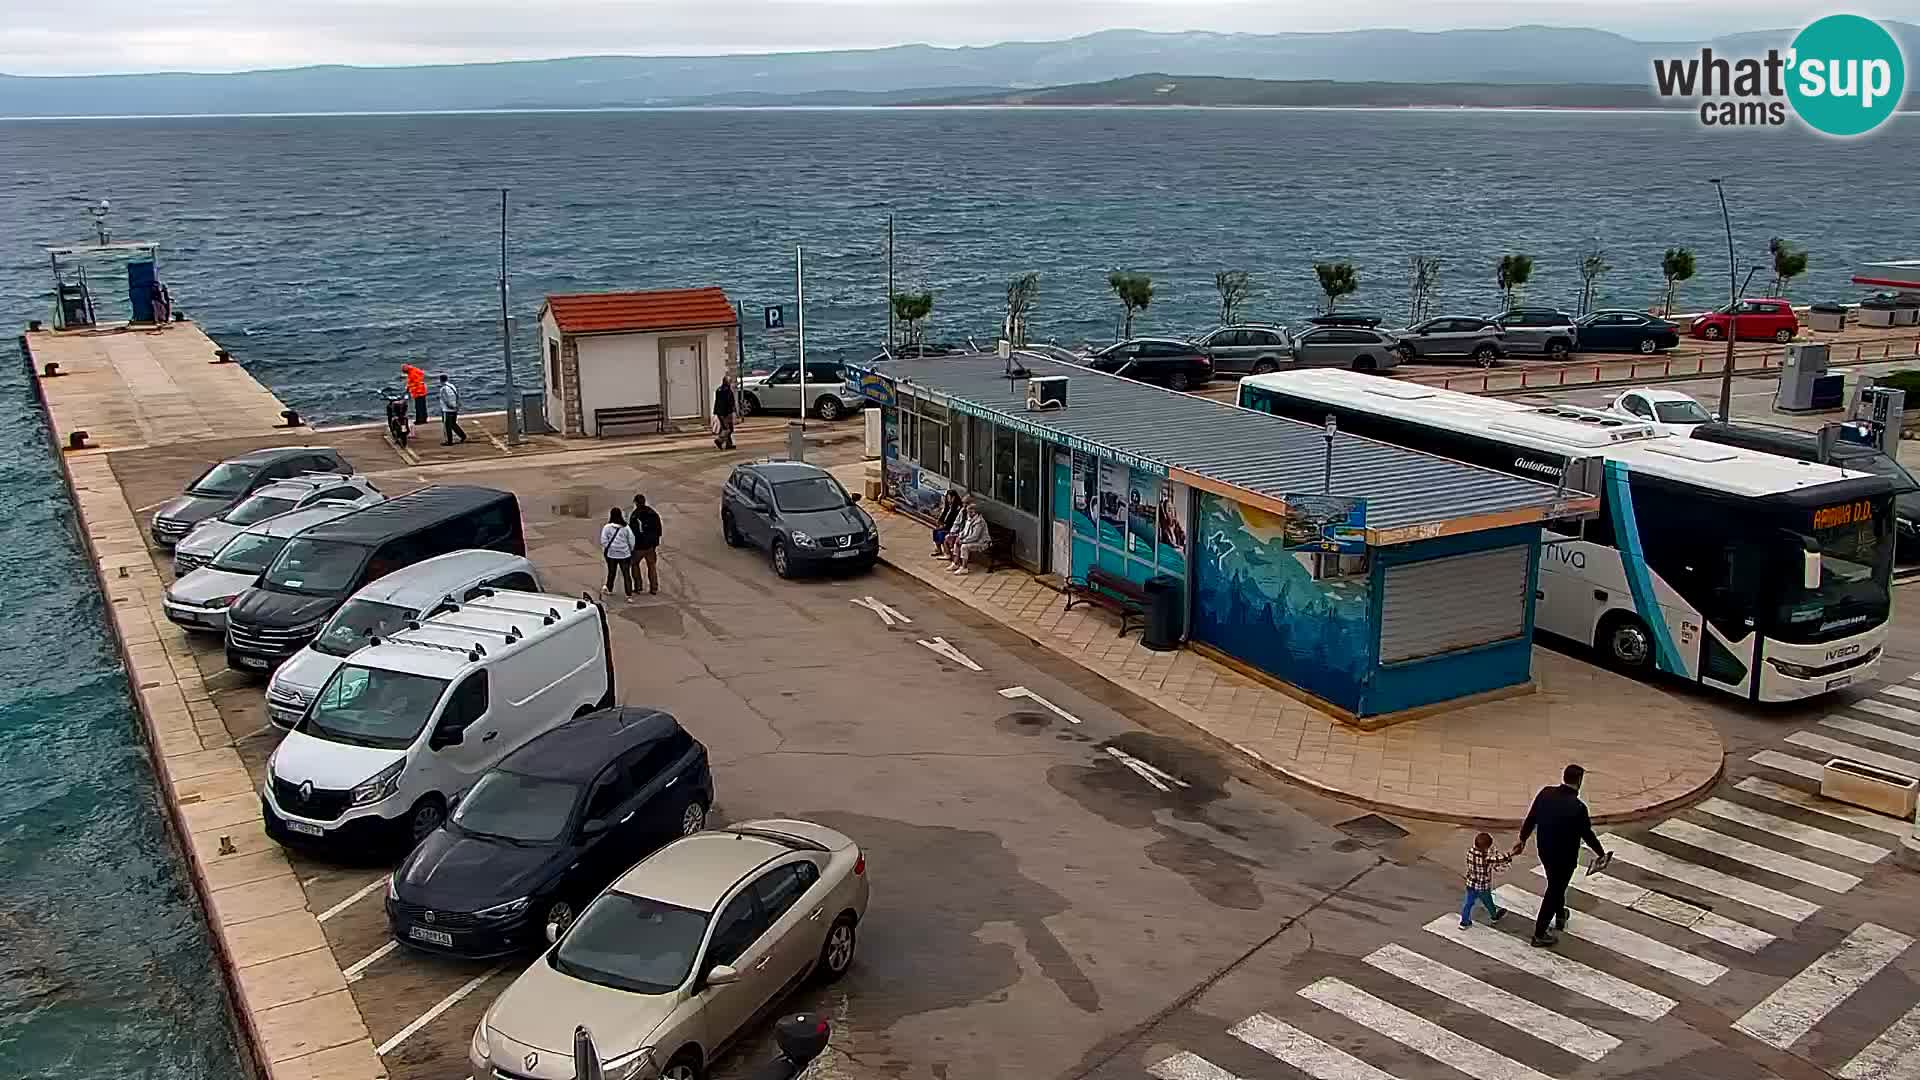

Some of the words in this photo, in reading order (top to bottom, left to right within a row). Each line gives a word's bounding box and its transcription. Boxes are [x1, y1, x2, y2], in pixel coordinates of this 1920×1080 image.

[768, 308, 780, 327] P
[1030, 425, 1058, 441] POSTAJA
[1068, 436, 1082, 449] BUS
[1083, 442, 1112, 460] STATION
[1115, 452, 1139, 468] TICKET
[1140, 459, 1165, 475] OFFICE
[1546, 543, 1585, 568] riva
[1825, 643, 1860, 661] IVECO
